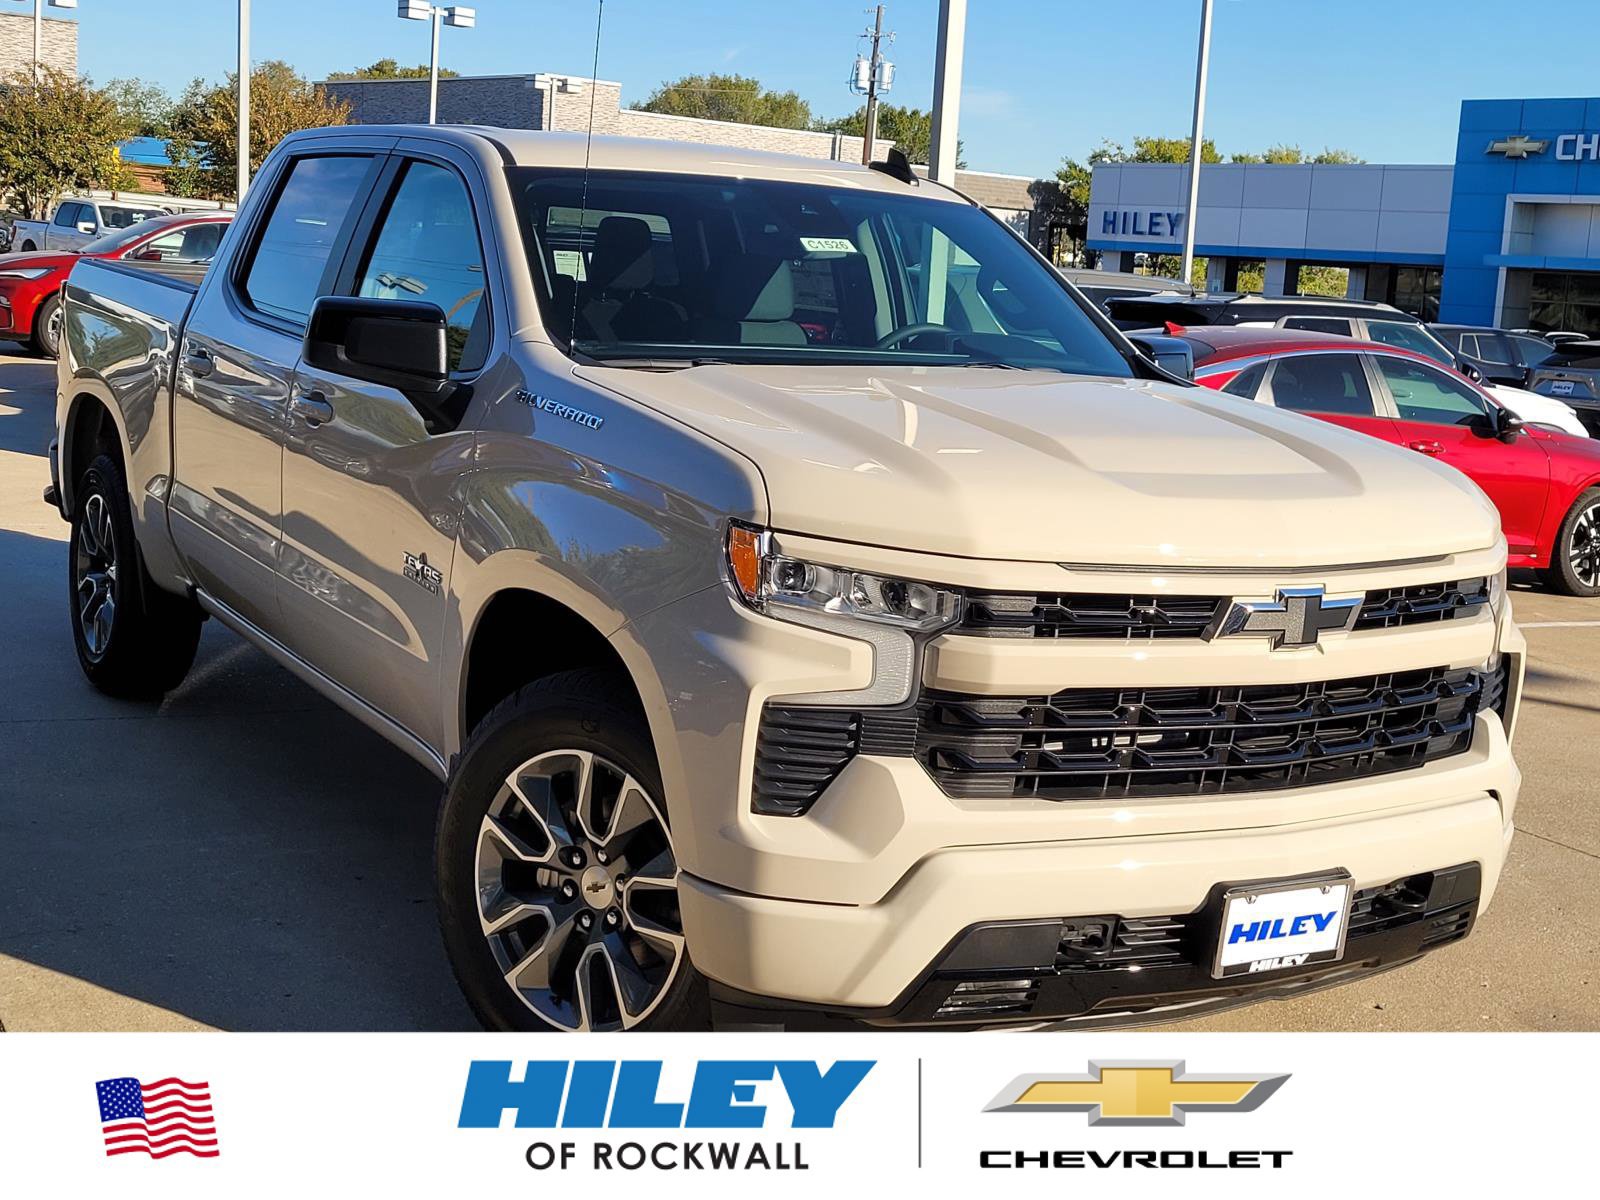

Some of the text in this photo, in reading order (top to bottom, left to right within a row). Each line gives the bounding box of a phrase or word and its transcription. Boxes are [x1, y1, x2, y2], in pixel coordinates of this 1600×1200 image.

[1102, 211, 1184, 236] HILEY
[807, 240, 849, 250] C1526
[516, 390, 604, 431] SILVERADO
[402, 551, 443, 585] TEXAS
[1228, 911, 1338, 945] HILEY
[1249, 953, 1311, 973] HILEY
